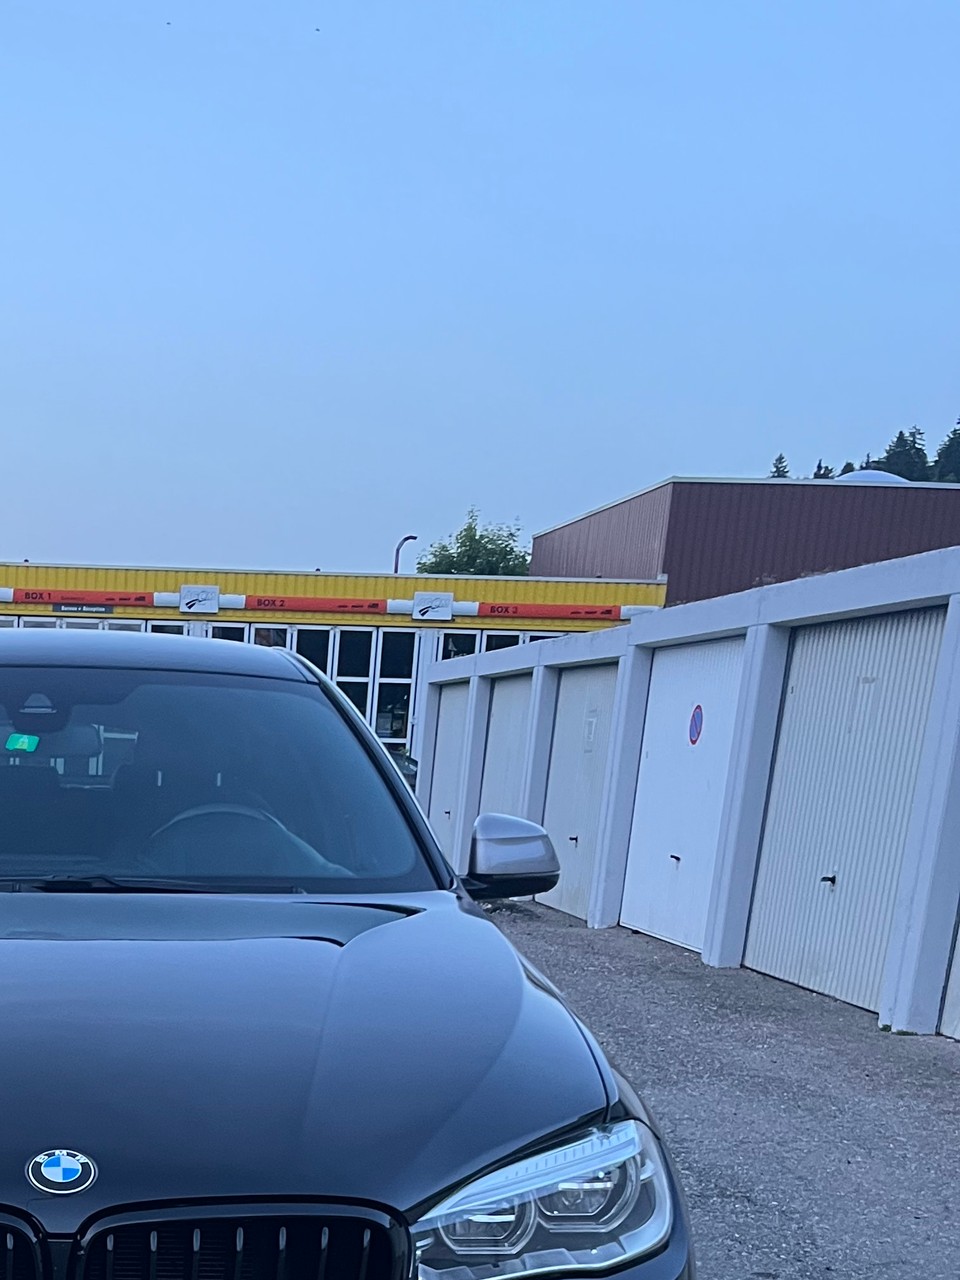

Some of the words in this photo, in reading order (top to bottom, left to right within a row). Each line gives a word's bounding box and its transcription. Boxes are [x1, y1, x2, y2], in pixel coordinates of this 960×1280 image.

[24, 592, 45, 600] BOX
[47, 592, 52, 600] 1
[256, 598, 277, 607] BOX
[489, 605, 510, 614] BOX
[35, 1149, 89, 1163] BMW
